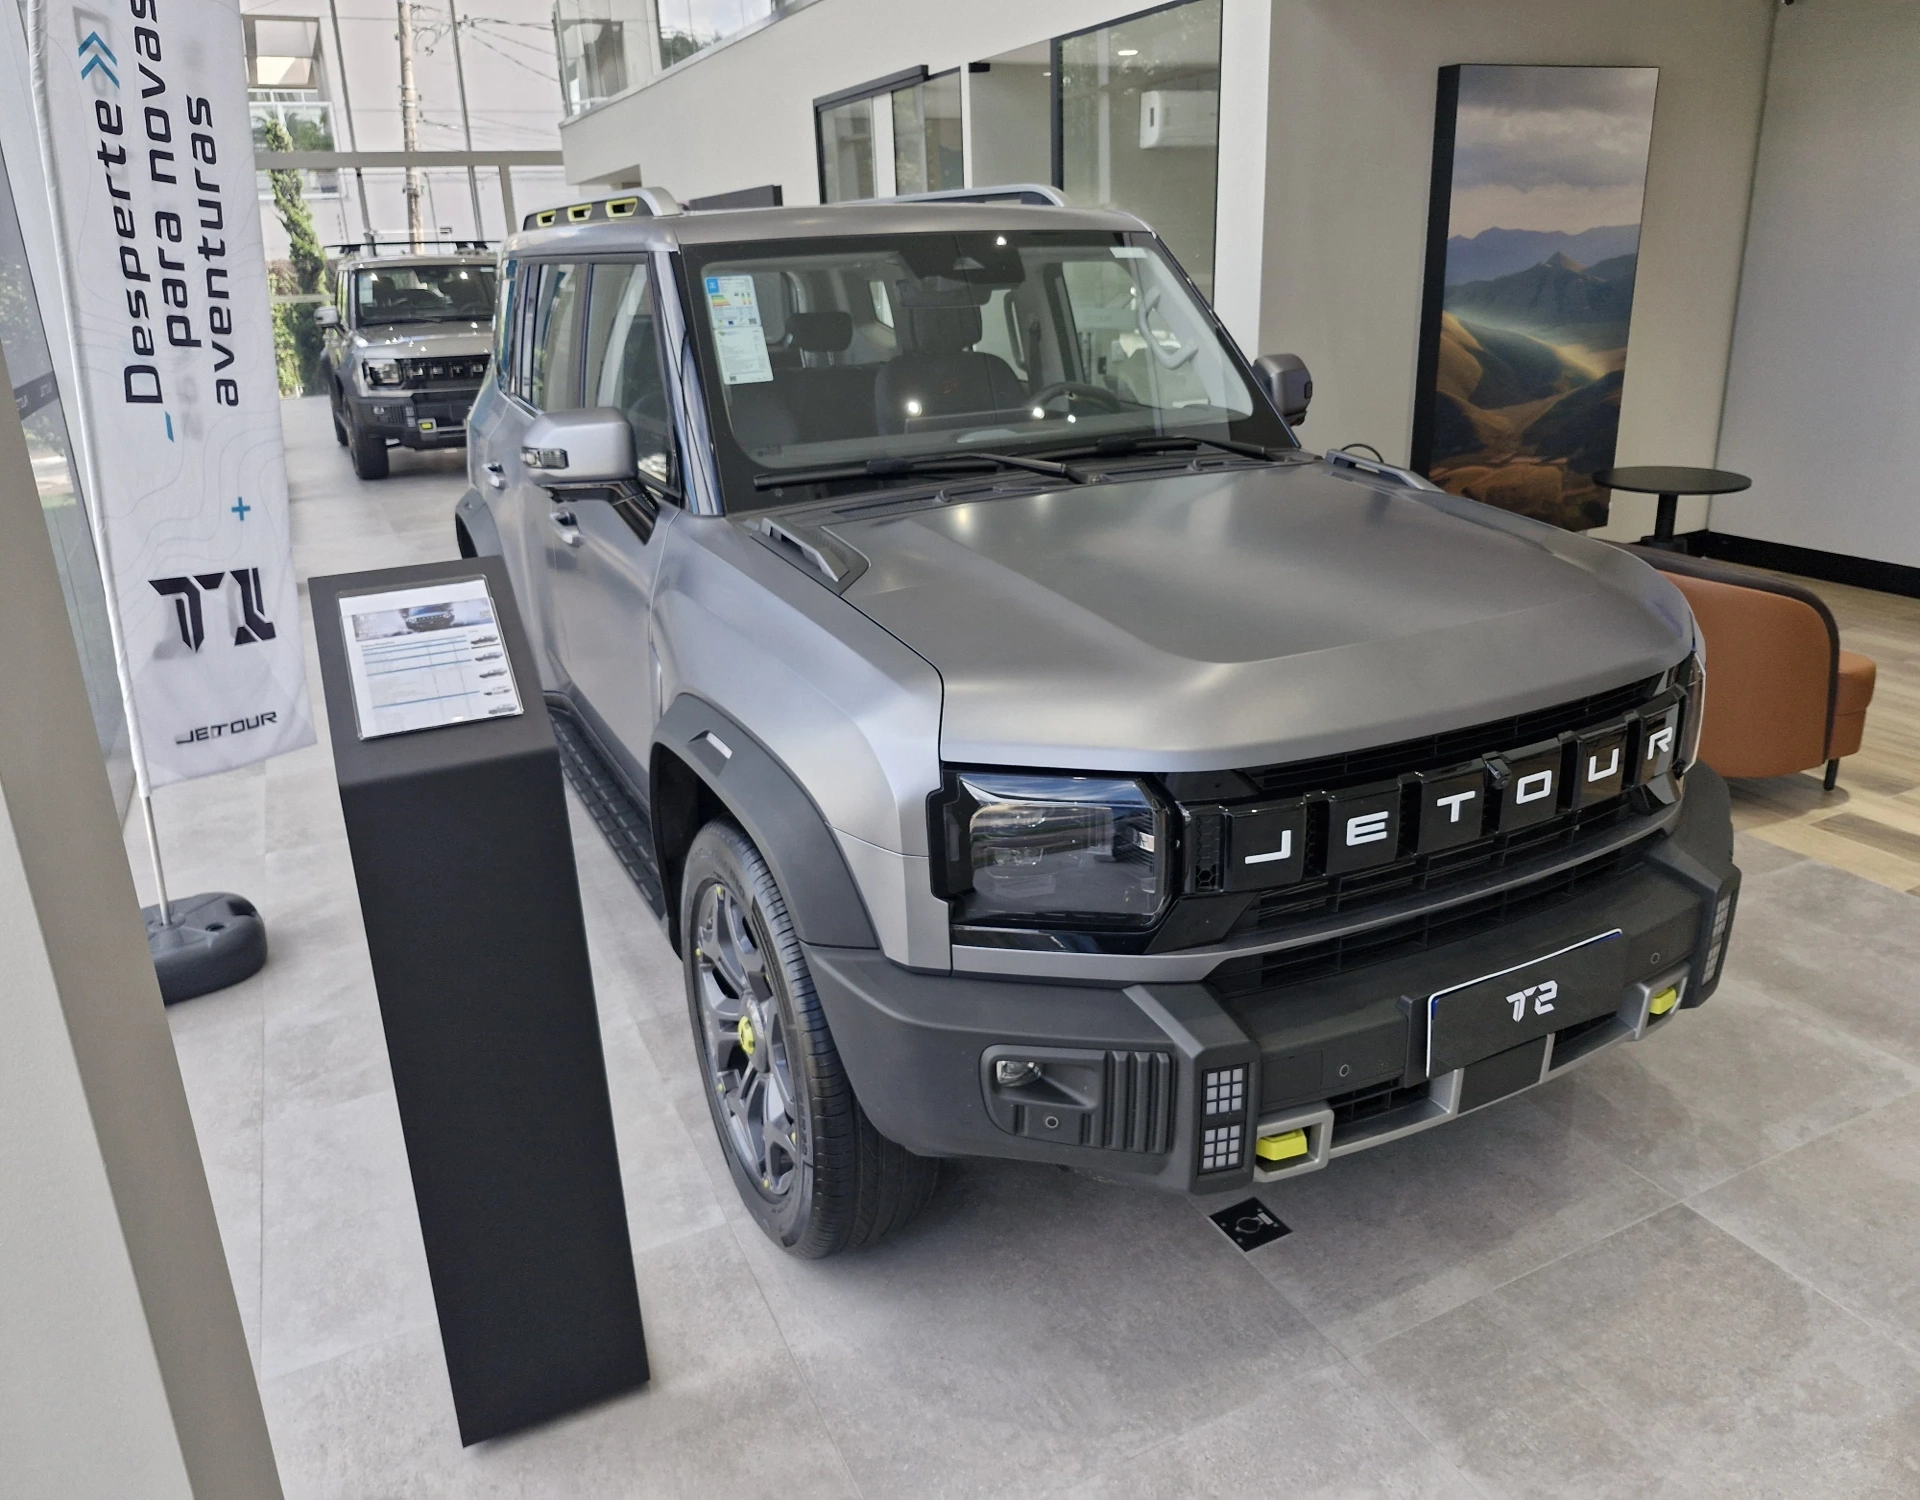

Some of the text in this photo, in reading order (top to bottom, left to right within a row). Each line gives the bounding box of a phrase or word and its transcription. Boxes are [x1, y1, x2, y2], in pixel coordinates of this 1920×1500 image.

[95, 99, 163, 404] Desperte
[131, 0, 202, 348] para novas
[186, 94, 239, 407] aventuras
[175, 711, 278, 745] JETOUR
[1245, 726, 1674, 865] JETOUR
[1505, 980, 1558, 1023] T2
